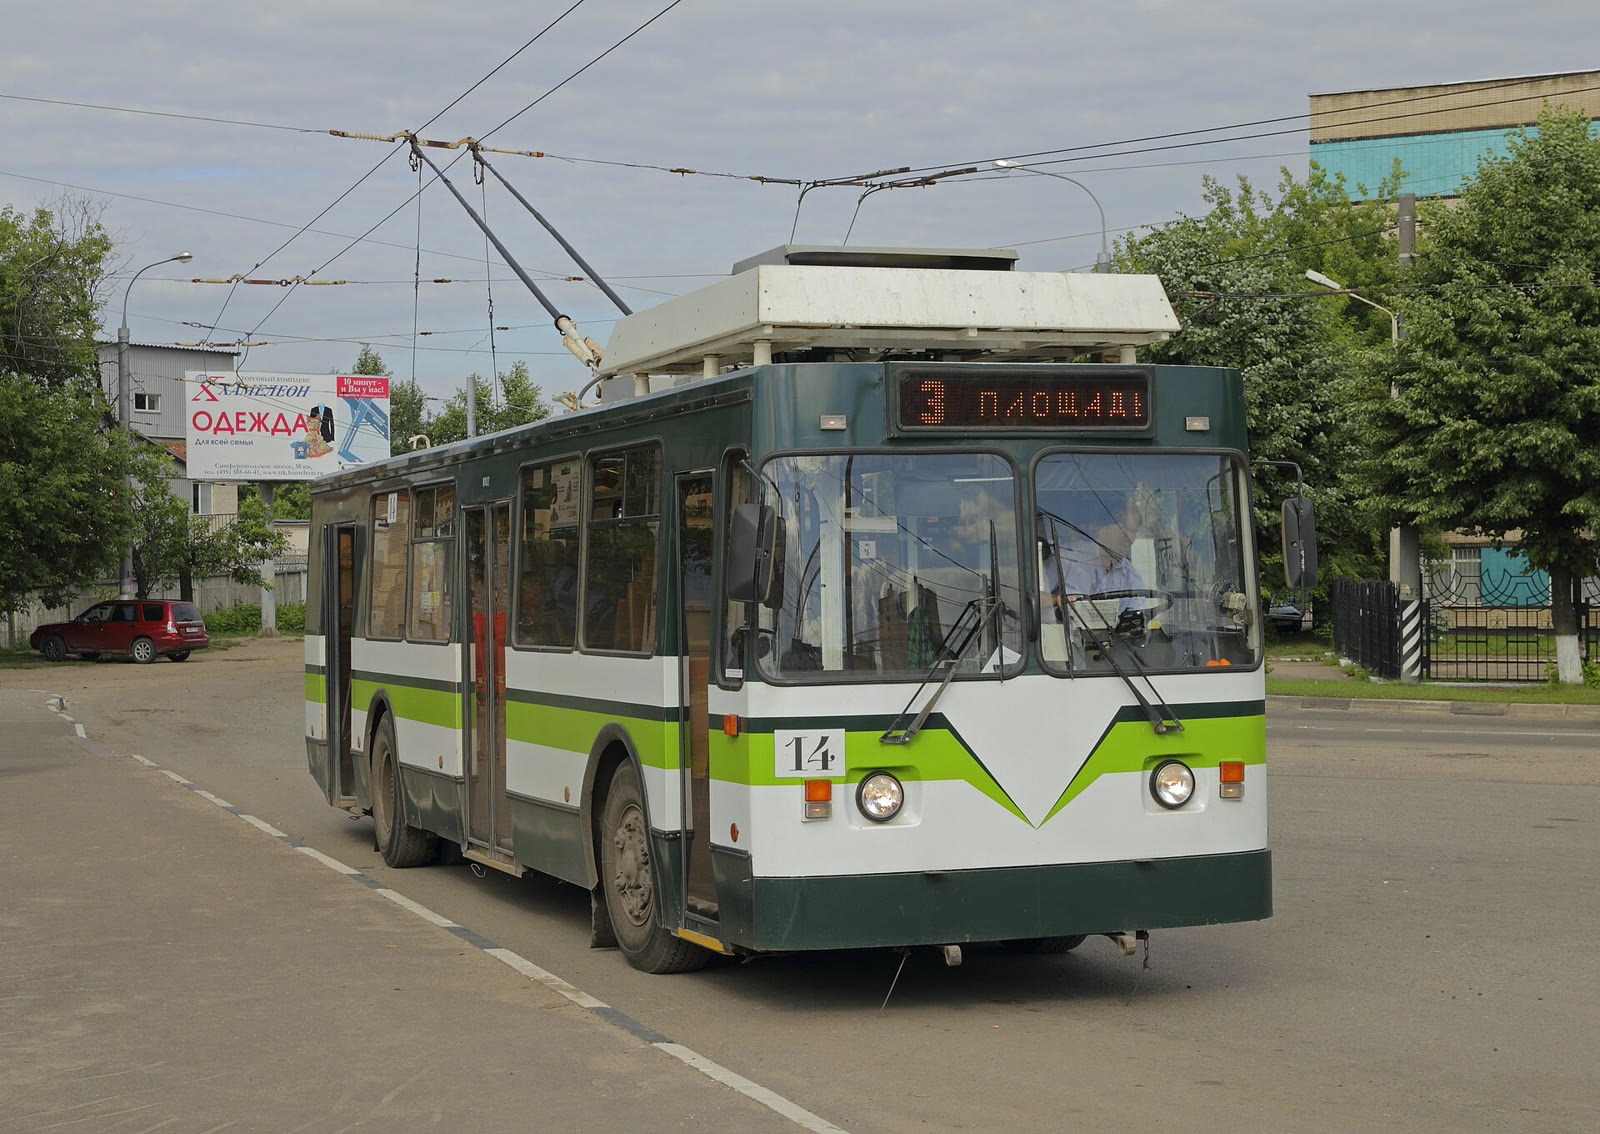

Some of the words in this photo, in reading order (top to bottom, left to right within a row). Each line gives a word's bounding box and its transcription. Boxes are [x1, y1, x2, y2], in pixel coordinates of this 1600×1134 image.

[218, 384, 311, 397] ХАМЕЛЕОН
[921, 380, 944, 424] 3
[192, 410, 309, 436] ОДЕЖДА
[785, 736, 836, 771] 14
